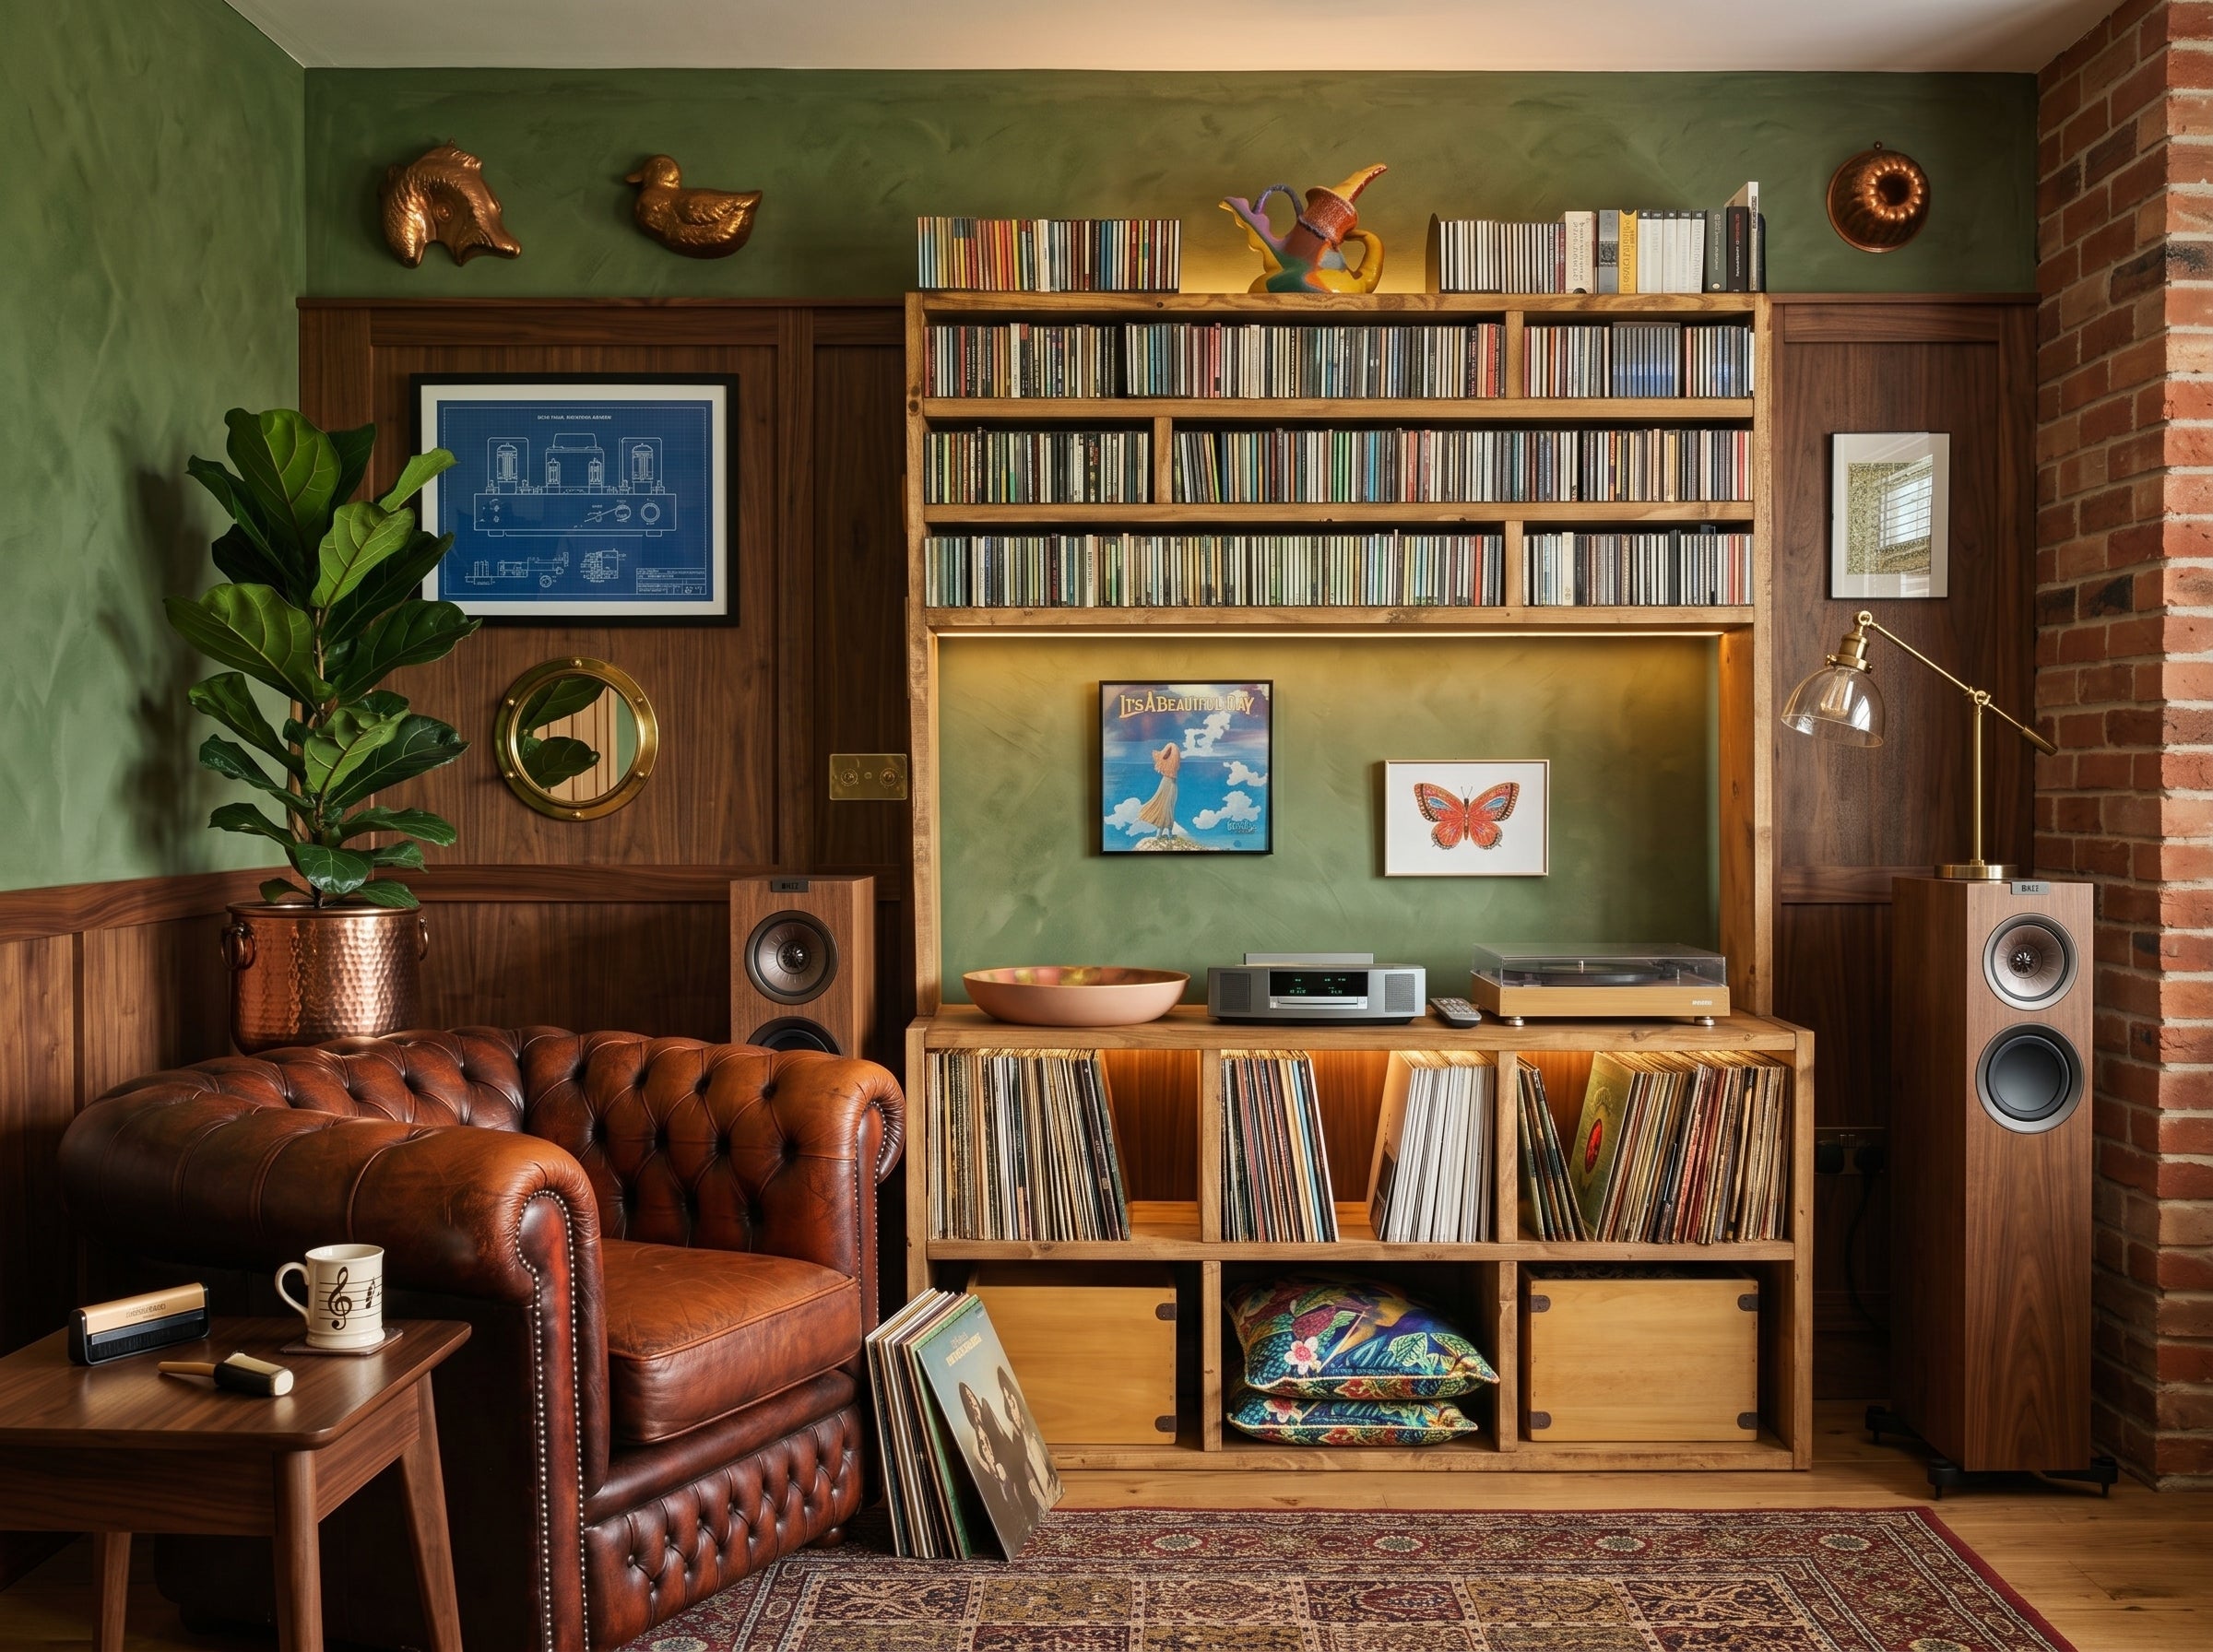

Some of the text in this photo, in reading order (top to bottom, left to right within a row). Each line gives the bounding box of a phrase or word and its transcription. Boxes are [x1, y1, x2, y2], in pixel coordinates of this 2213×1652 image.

[1144, 690, 1156, 713] A
[1156, 696, 1223, 713] BEAUTIFUL
[1226, 694, 1255, 716] DAY
